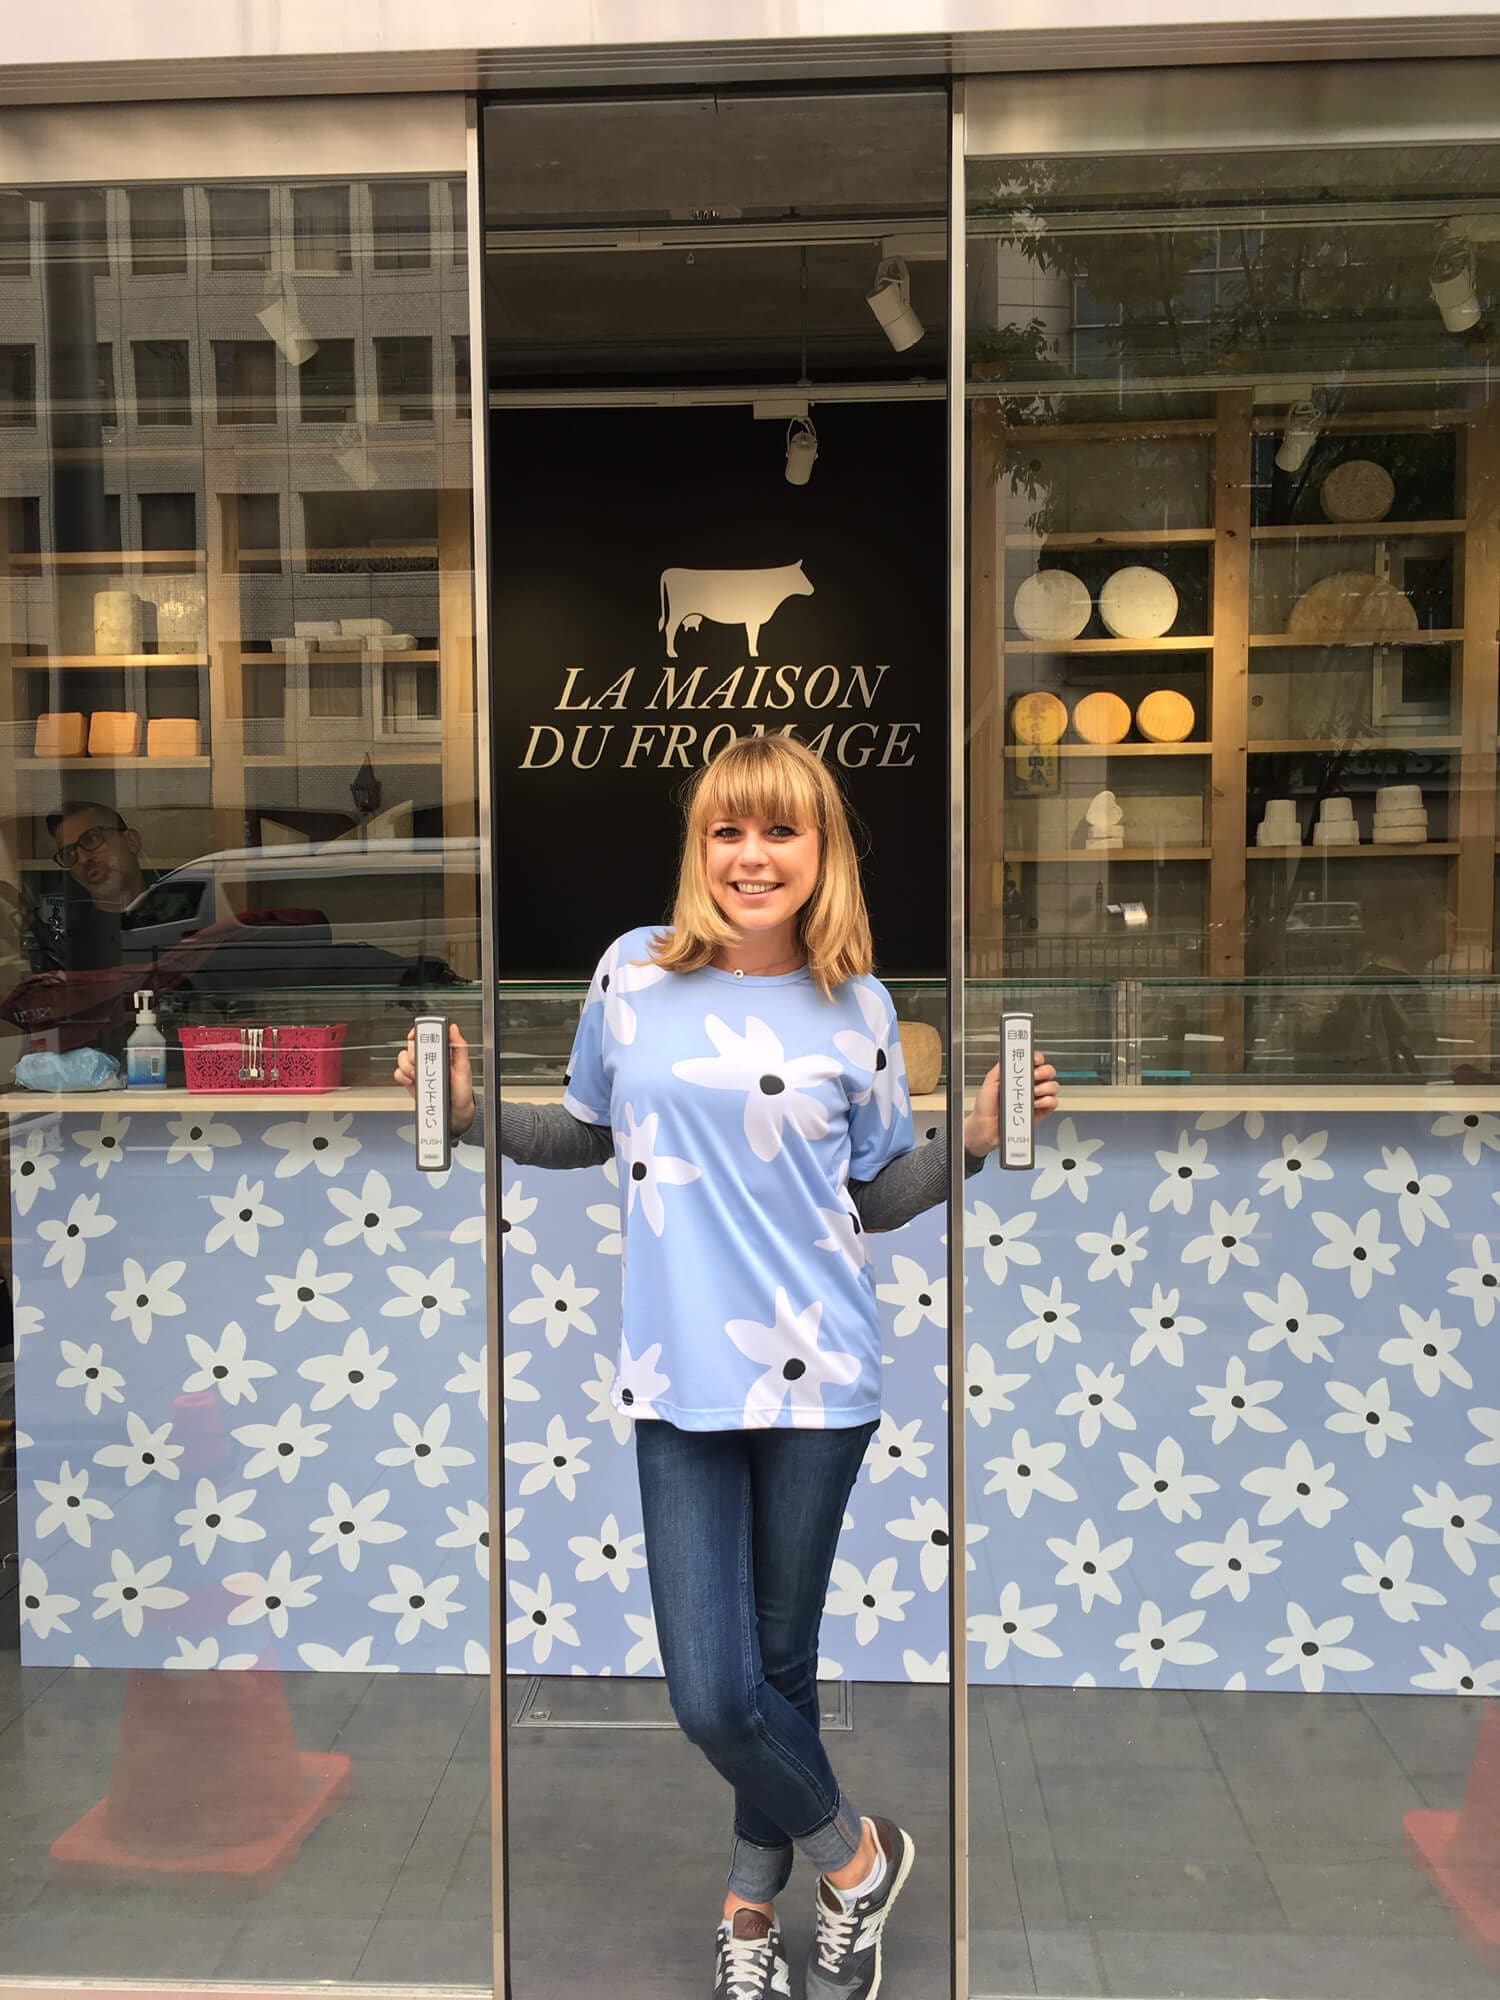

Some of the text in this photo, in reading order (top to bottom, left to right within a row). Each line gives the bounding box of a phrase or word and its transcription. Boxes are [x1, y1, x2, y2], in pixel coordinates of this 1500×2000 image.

[554, 664, 891, 711] LA MAISON
[518, 724, 614, 769] DU
[420, 1033, 440, 1044] 自動
[1007, 1029, 1028, 1040] 自動
[424, 1052, 438, 1129] 押して下さい
[1012, 1048, 1025, 1127] 押して下さい
[420, 1136, 443, 1145] PUSH
[1007, 1136, 1030, 1144] PUSH
